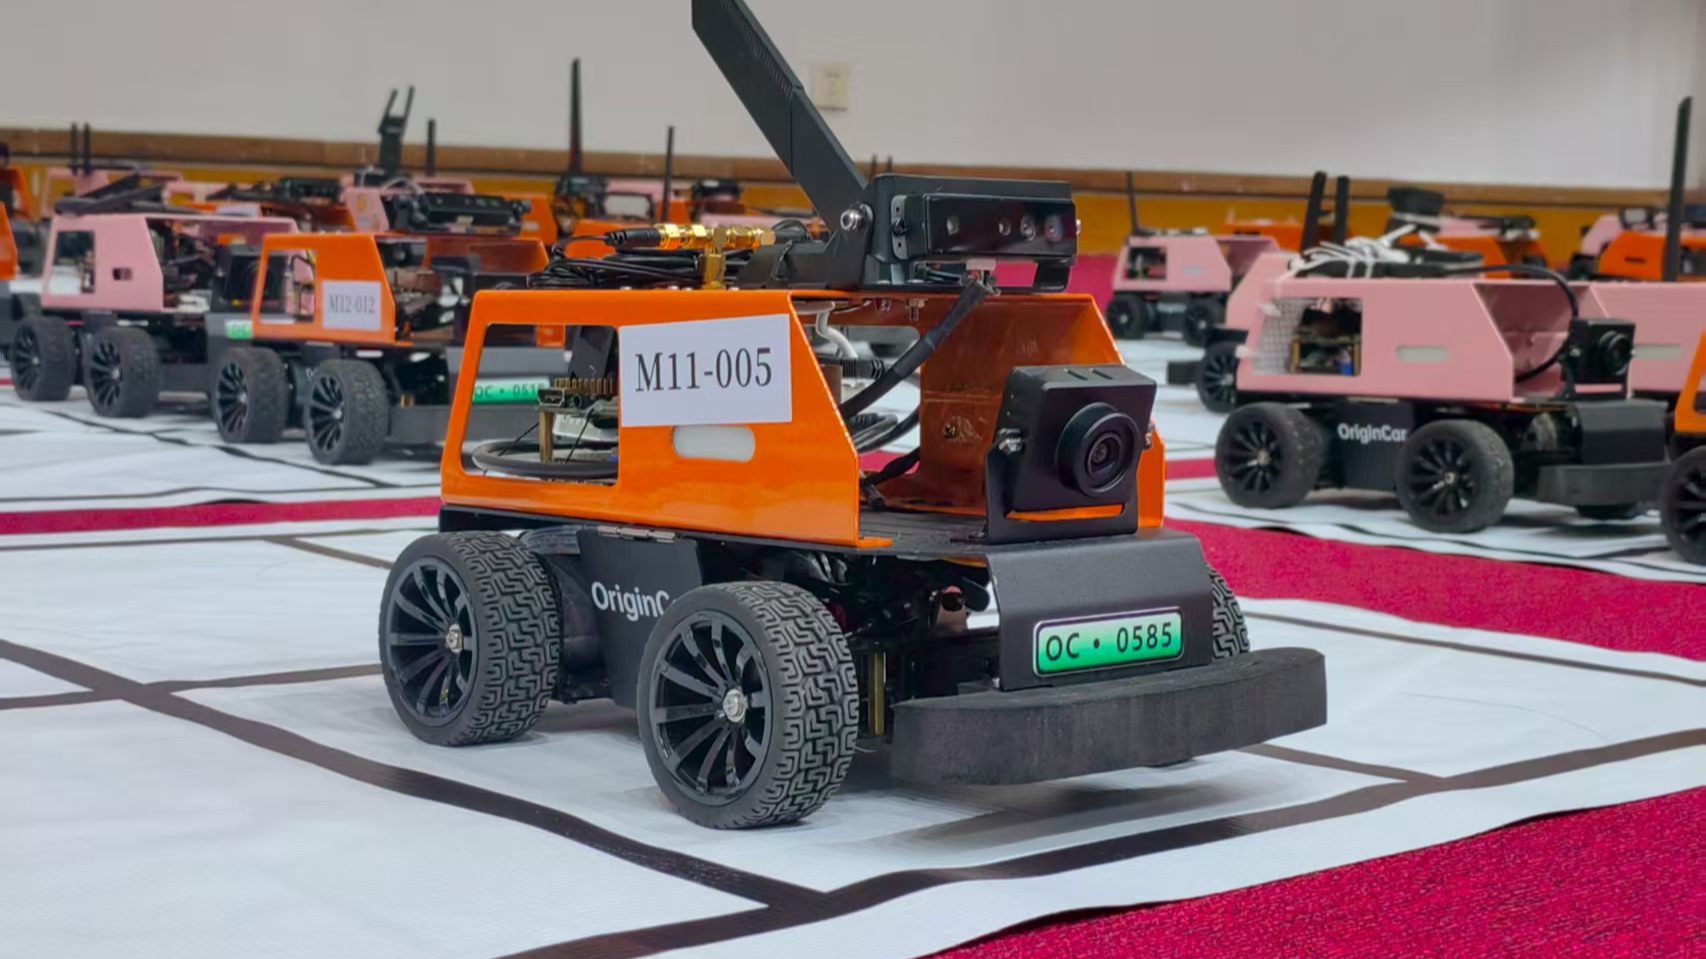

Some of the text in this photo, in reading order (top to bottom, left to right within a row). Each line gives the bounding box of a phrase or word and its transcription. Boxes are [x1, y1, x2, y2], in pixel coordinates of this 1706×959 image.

[329, 293, 376, 314] M12-012
[635, 347, 772, 392] M11-005
[1338, 423, 1406, 444] OriginCar
[591, 581, 675, 622] OriginC
[1046, 632, 1080, 661] OC
[1116, 622, 1172, 653] 0585
